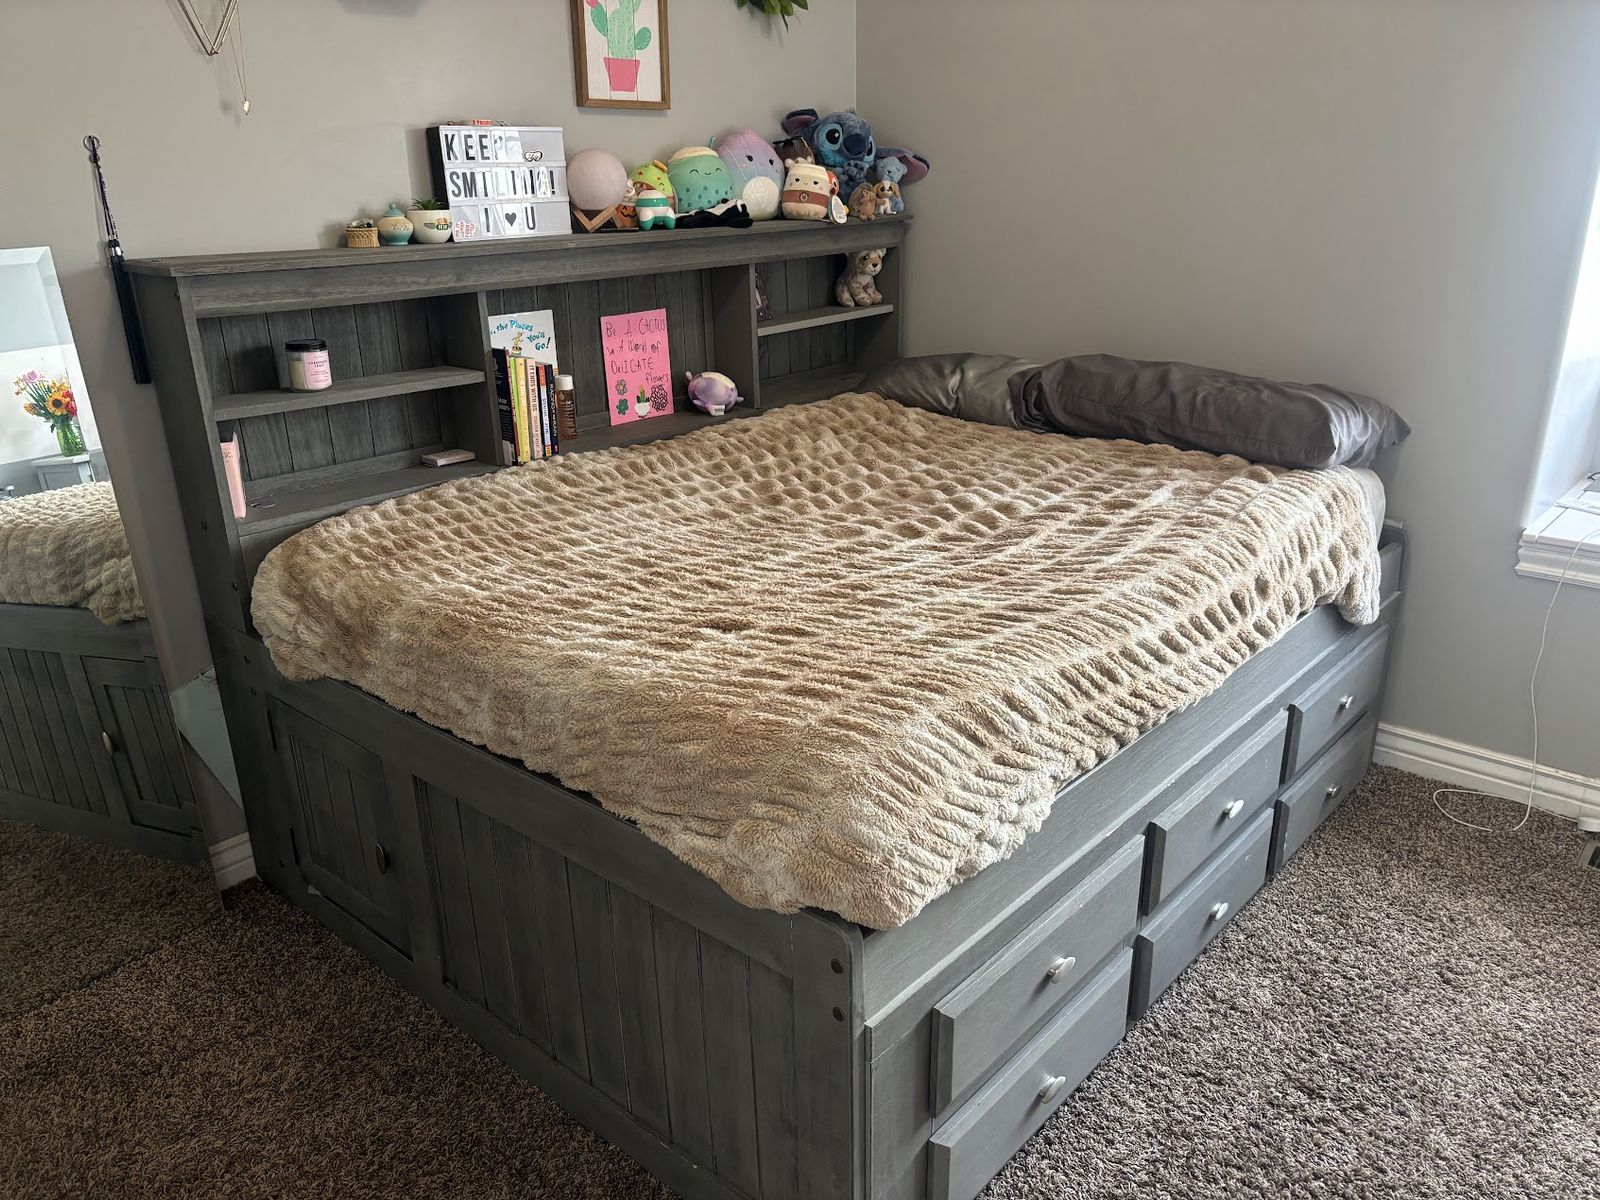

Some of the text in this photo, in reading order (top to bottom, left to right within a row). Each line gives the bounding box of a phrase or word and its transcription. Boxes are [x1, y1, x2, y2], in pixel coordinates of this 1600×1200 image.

[484, 207, 491, 233] I
[525, 206, 537, 231] U
[496, 319, 534, 332] the Places
[535, 336, 552, 351] Go!
[532, 403, 538, 412] US
